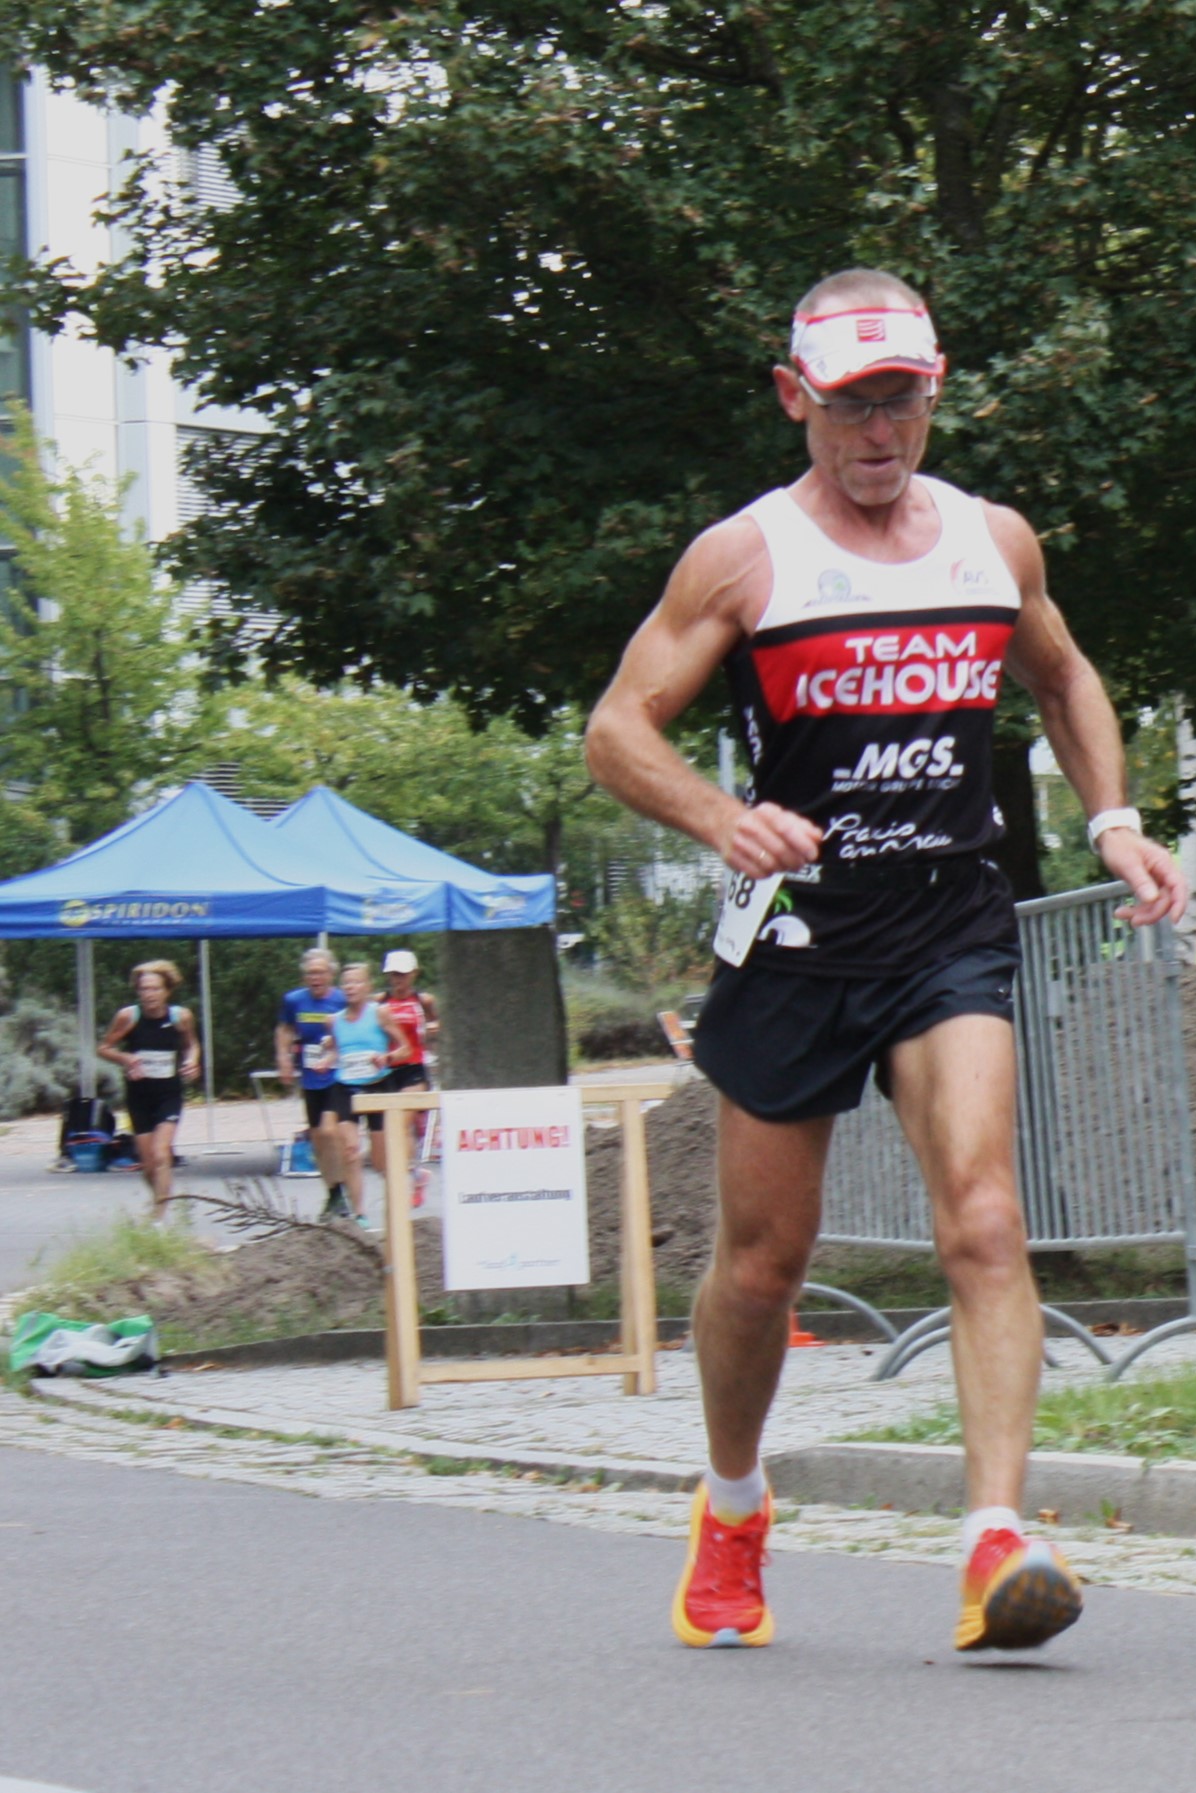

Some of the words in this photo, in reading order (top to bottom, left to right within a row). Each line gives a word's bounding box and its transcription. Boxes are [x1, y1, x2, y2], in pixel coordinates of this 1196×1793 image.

[844, 630, 978, 665] TEAM
[795, 659, 1002, 710] ICEHOUSE
[89, 902, 209, 921] SPIRIDON
[457, 1125, 571, 1153] ACHTUNG!
